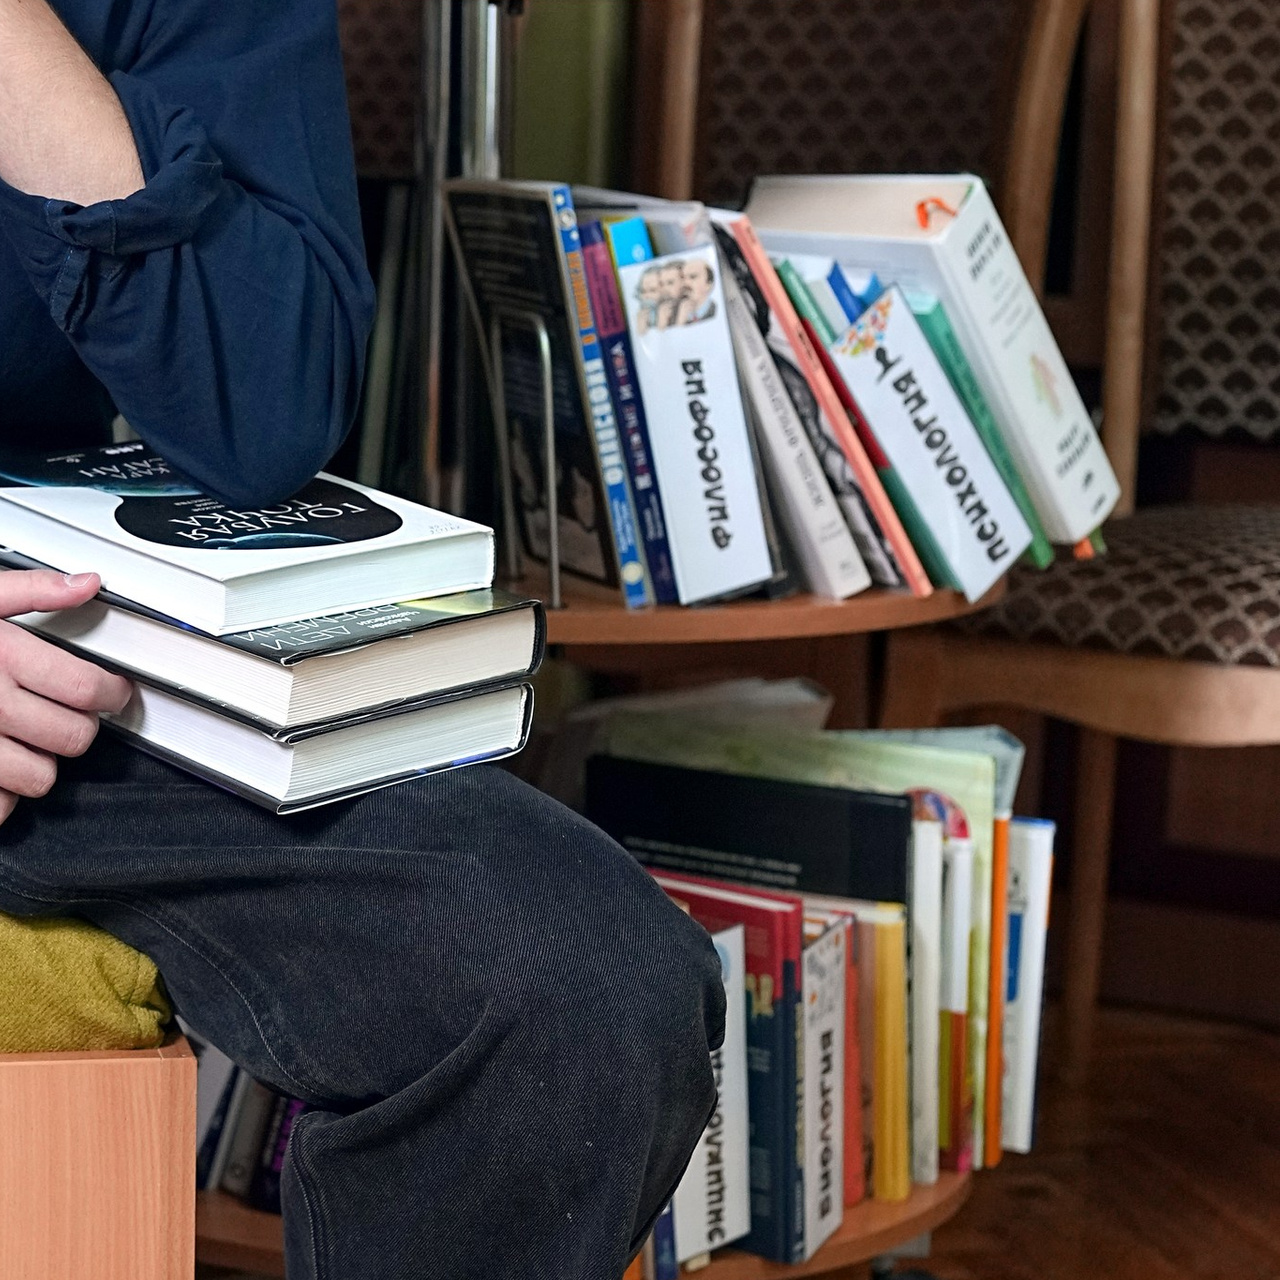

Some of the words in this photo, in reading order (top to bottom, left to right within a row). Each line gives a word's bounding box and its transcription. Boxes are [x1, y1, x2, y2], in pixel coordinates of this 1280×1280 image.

[175, 503, 369, 543] ГОЛУБАЯ
[260, 624, 352, 651] ДЕТИ
[703, 1049, 726, 1244] ЭНЦИКЛОД
